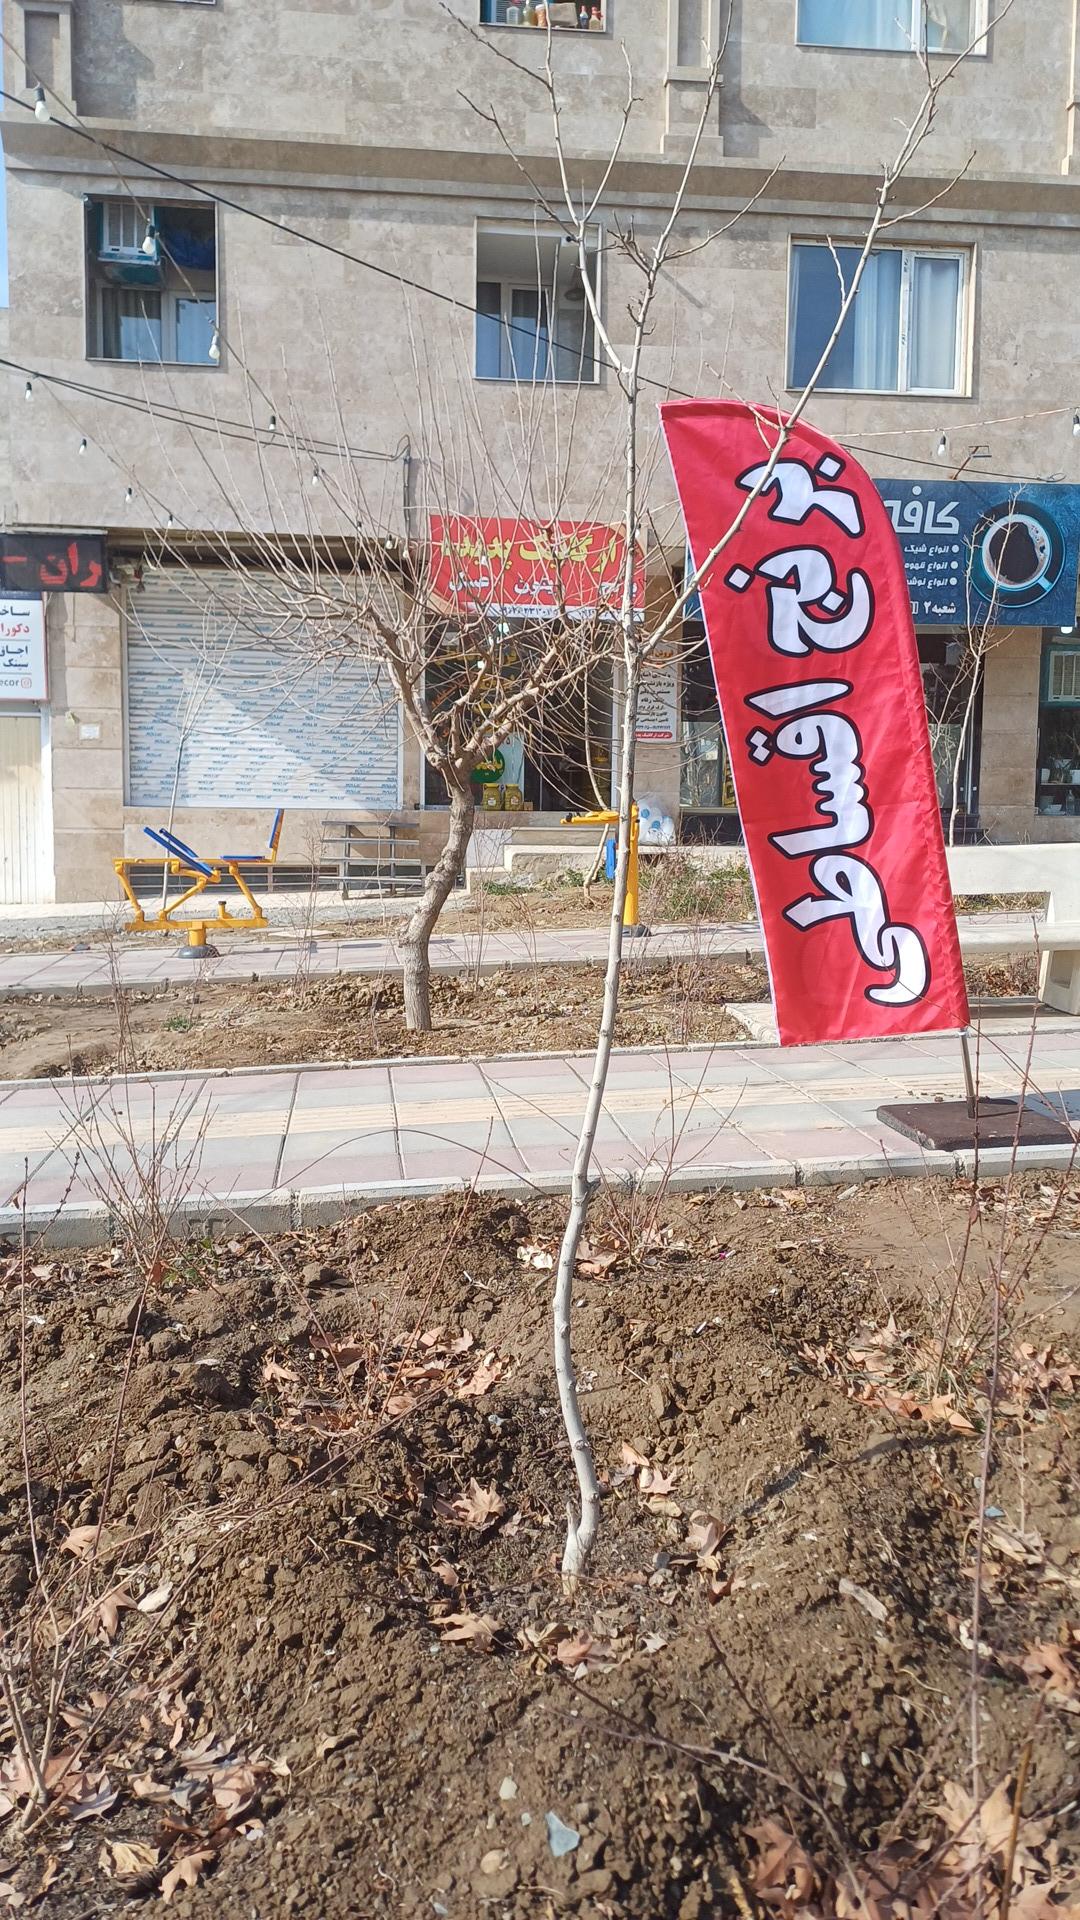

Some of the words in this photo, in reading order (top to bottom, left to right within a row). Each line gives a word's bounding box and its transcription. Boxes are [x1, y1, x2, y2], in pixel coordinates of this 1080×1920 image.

[724, 449, 876, 657] برنج
[904, 543, 927, 555] شیک
[928, 544, 950, 557] انواع
[927, 561, 948, 573] انواع
[927, 577, 949, 590] انواع
[931, 602, 957, 617] شعبه
[744, 677, 931, 1008] اقساطی
